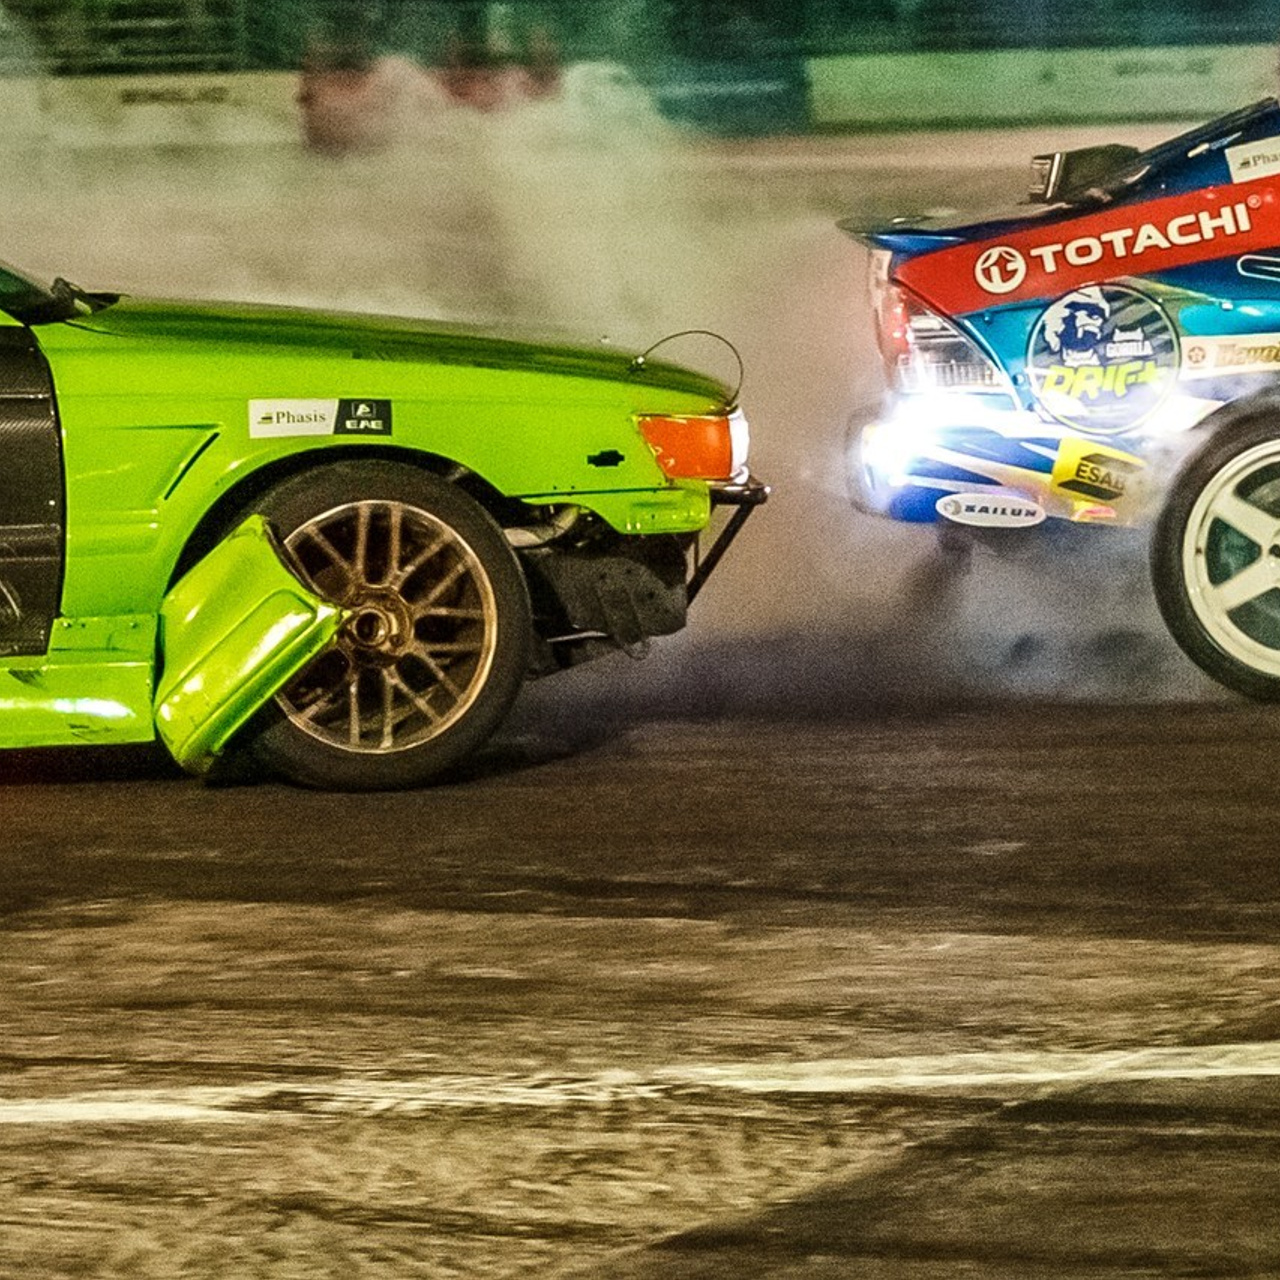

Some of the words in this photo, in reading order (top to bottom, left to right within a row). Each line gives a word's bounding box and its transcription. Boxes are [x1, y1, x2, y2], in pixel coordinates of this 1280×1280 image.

[1252, 152, 1280, 167] Pha
[1030, 202, 1252, 273] TOTACHI
[276, 409, 327, 424] Phasis
